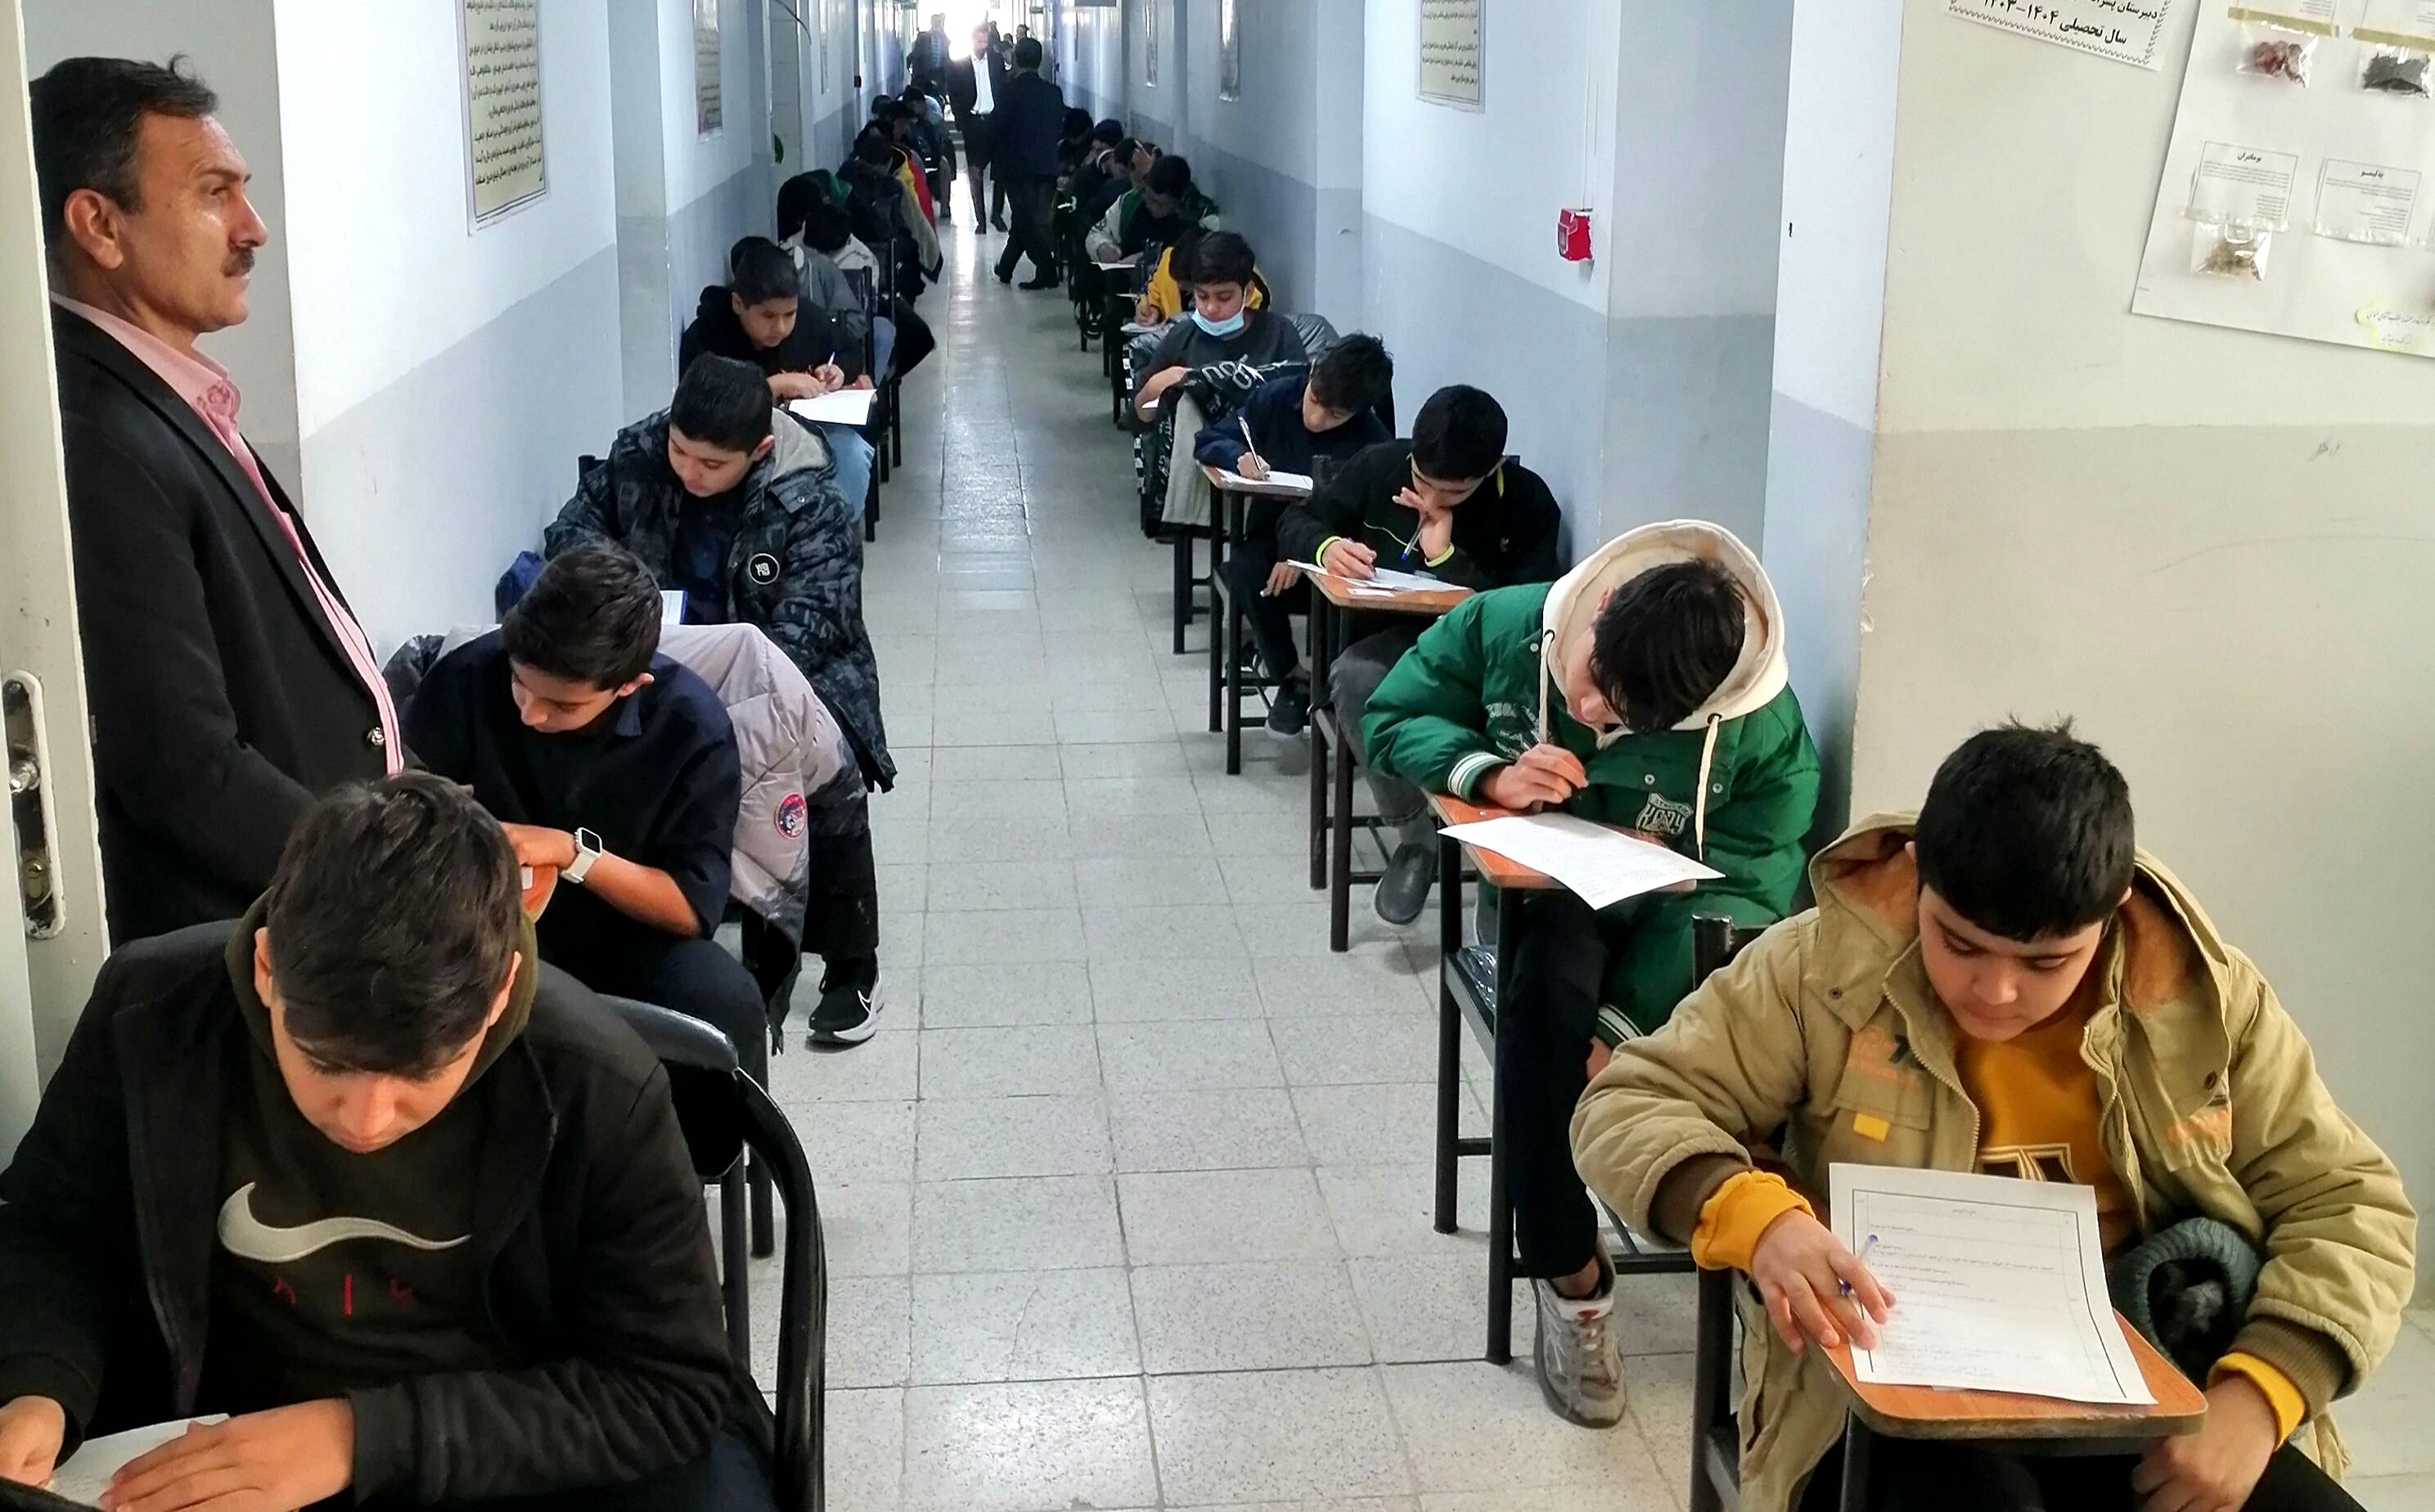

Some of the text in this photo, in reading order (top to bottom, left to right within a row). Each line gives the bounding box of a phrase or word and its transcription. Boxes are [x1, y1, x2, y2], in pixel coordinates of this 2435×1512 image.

[2116, 2, 2158, 20] دبیرستان
[2059, 17, 2104, 38] تحصیلی
[2104, 28, 2127, 44] سال
